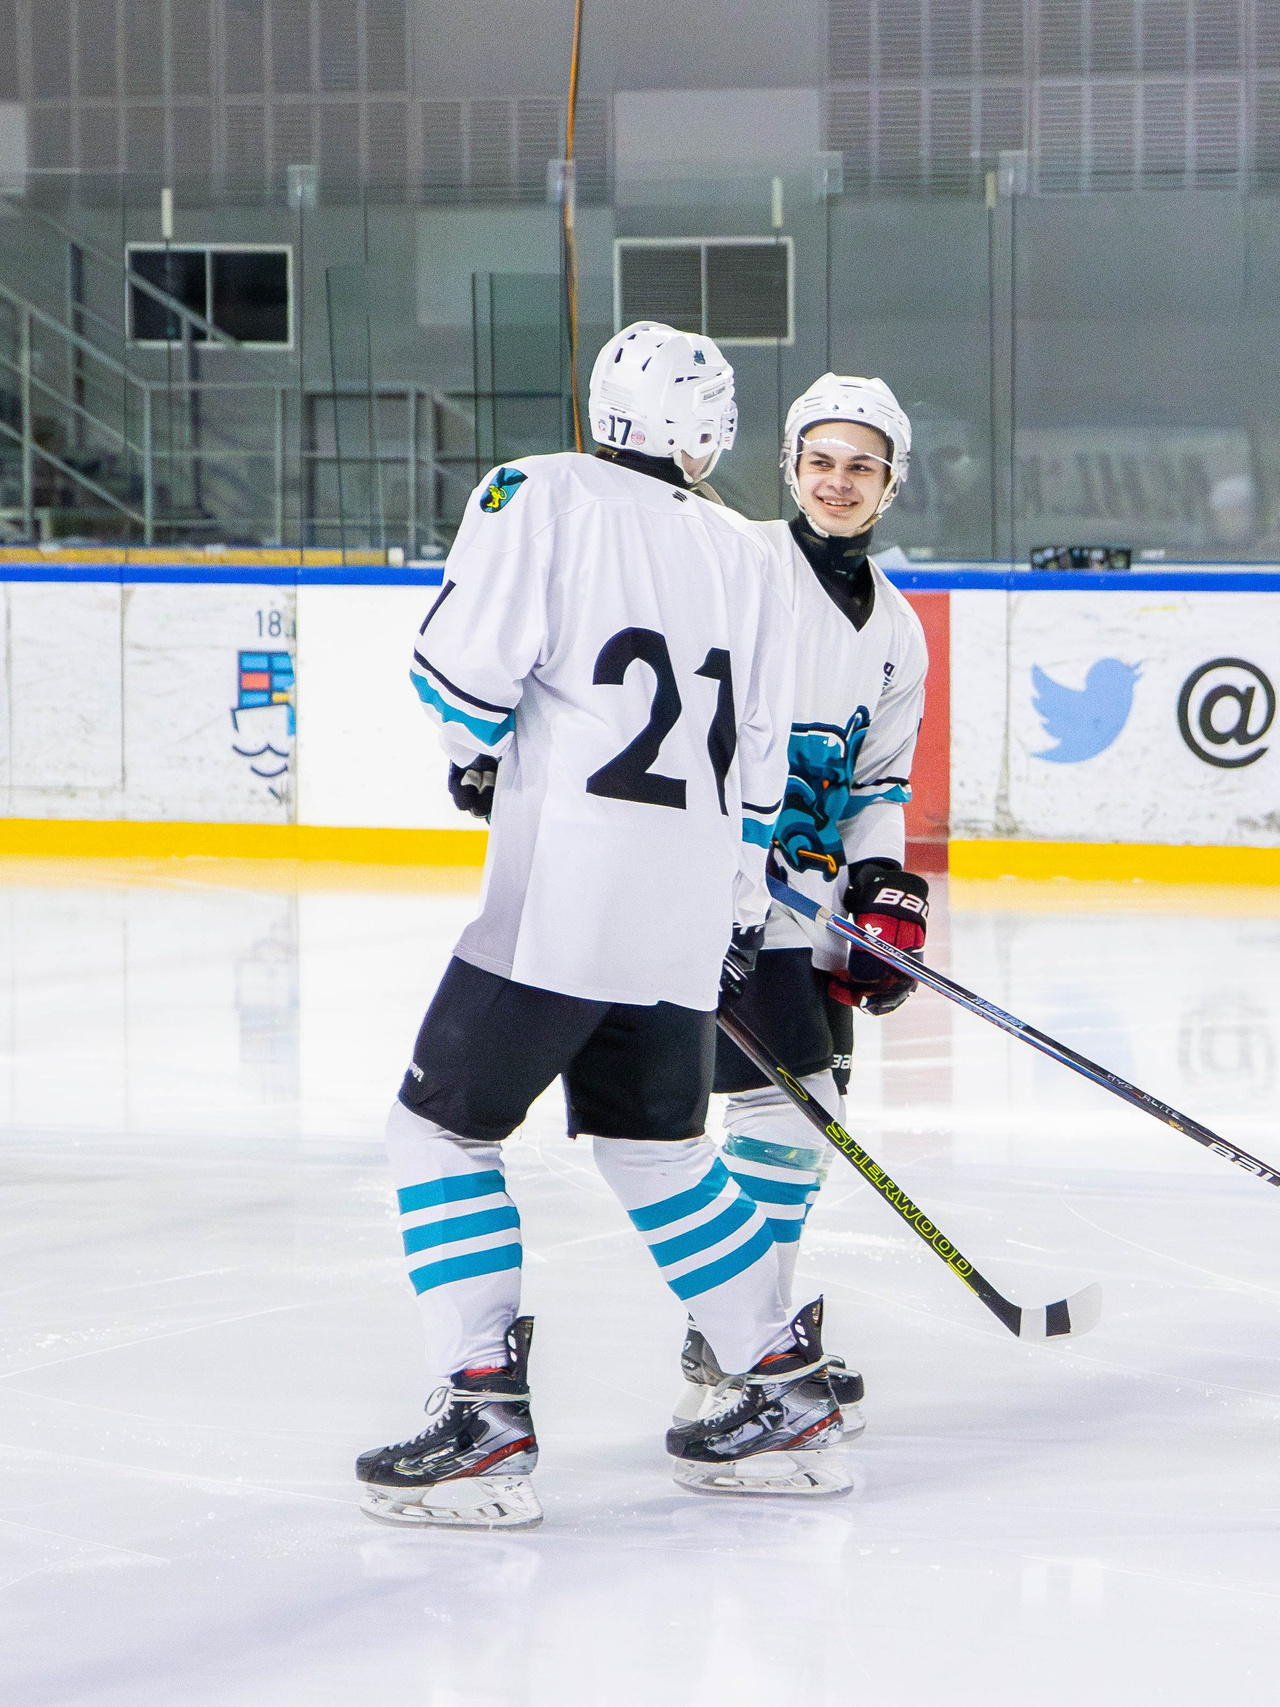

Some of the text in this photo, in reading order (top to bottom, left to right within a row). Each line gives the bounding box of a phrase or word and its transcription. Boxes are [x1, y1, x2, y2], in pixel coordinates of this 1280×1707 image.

[608, 414, 632, 446] 17
[586, 627, 737, 817] 21
[825, 1120, 974, 1278] SHERWOOD
